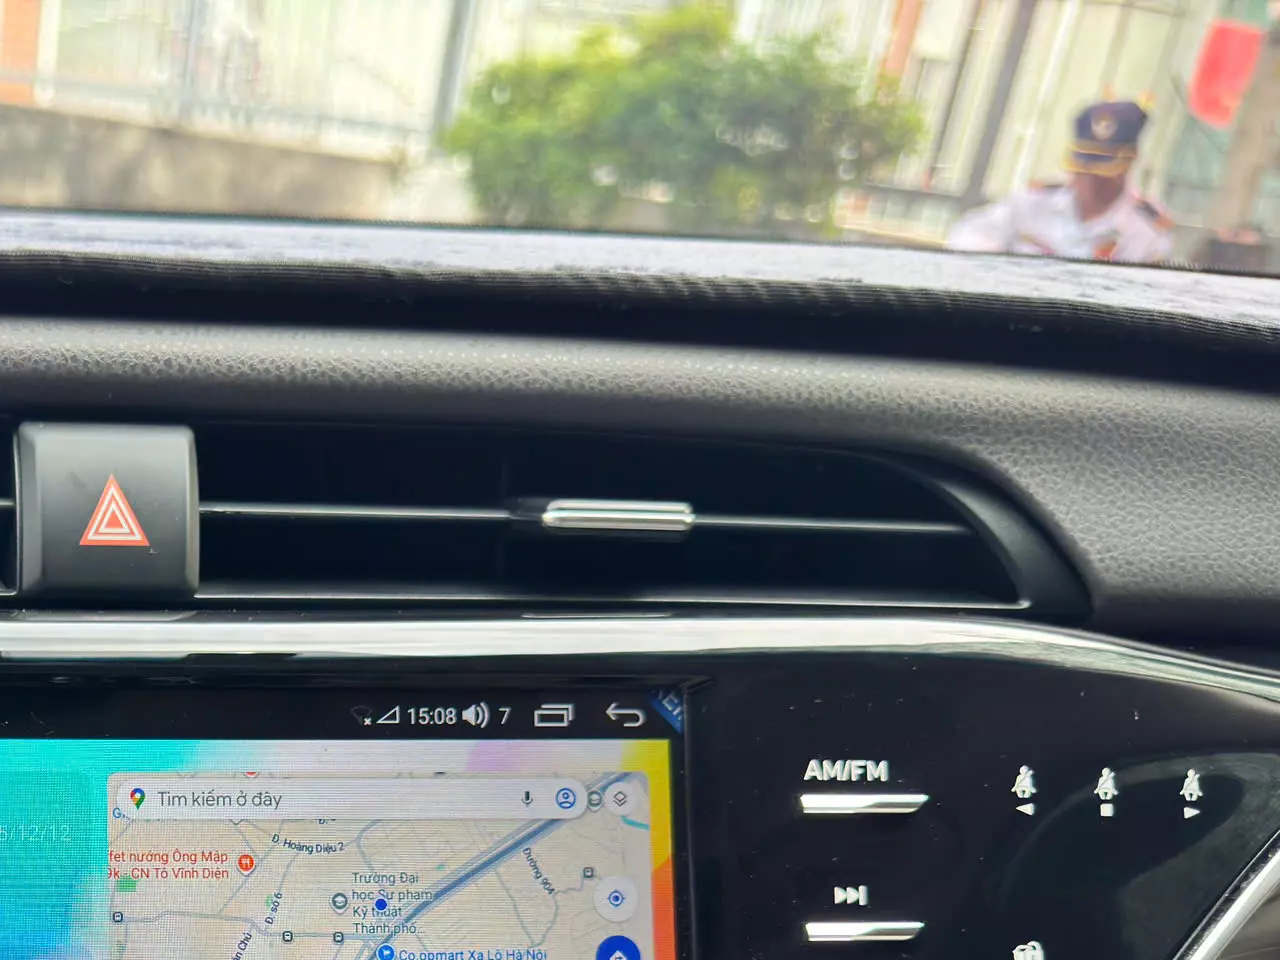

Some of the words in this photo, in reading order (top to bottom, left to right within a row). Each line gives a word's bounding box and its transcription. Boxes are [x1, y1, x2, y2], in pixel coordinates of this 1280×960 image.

[407, 707, 456, 725] 15:08
[498, 708, 511, 724] 7
[803, 759, 889, 782] AM/FM
[131, 867, 150, 879] CN
